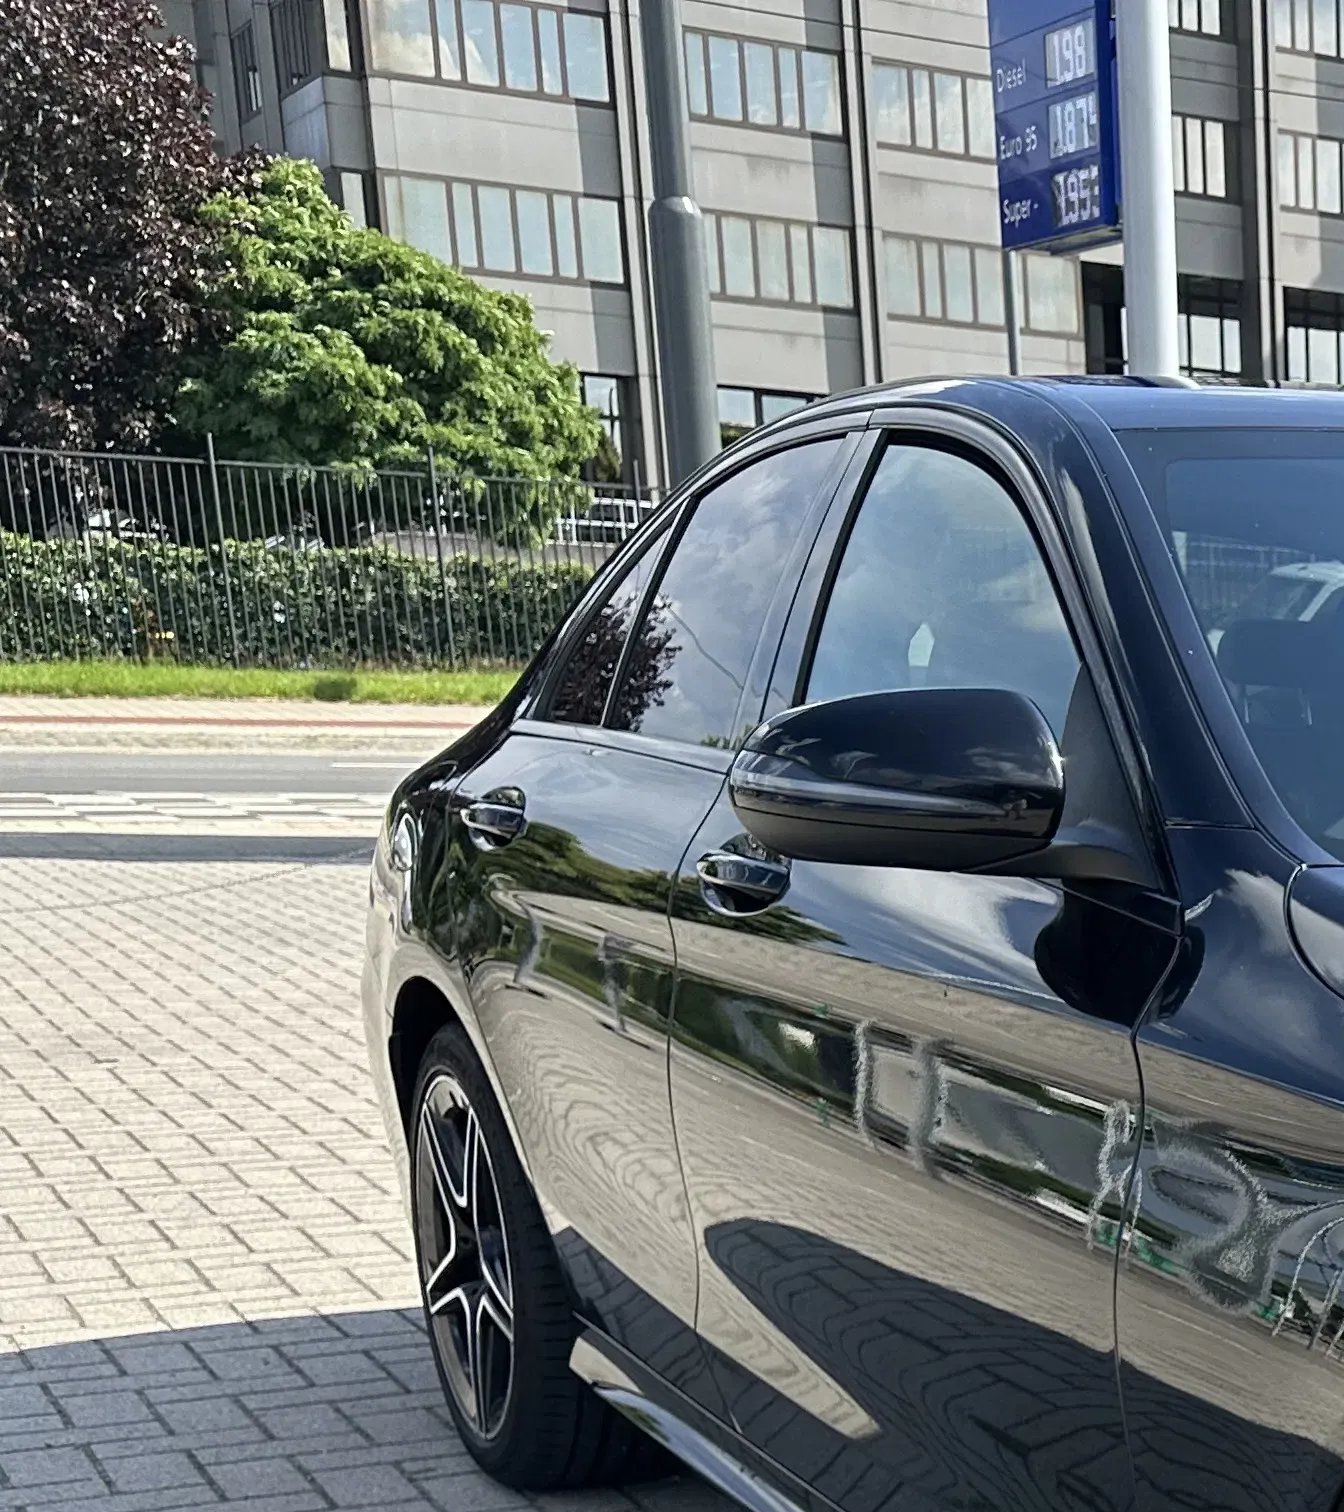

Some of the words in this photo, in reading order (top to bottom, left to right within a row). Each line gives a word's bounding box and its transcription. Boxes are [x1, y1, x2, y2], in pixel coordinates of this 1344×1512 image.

[996, 57, 1026, 93] Diesel
[1000, 135, 1022, 160] Euro
[1025, 125, 1038, 153] 95
